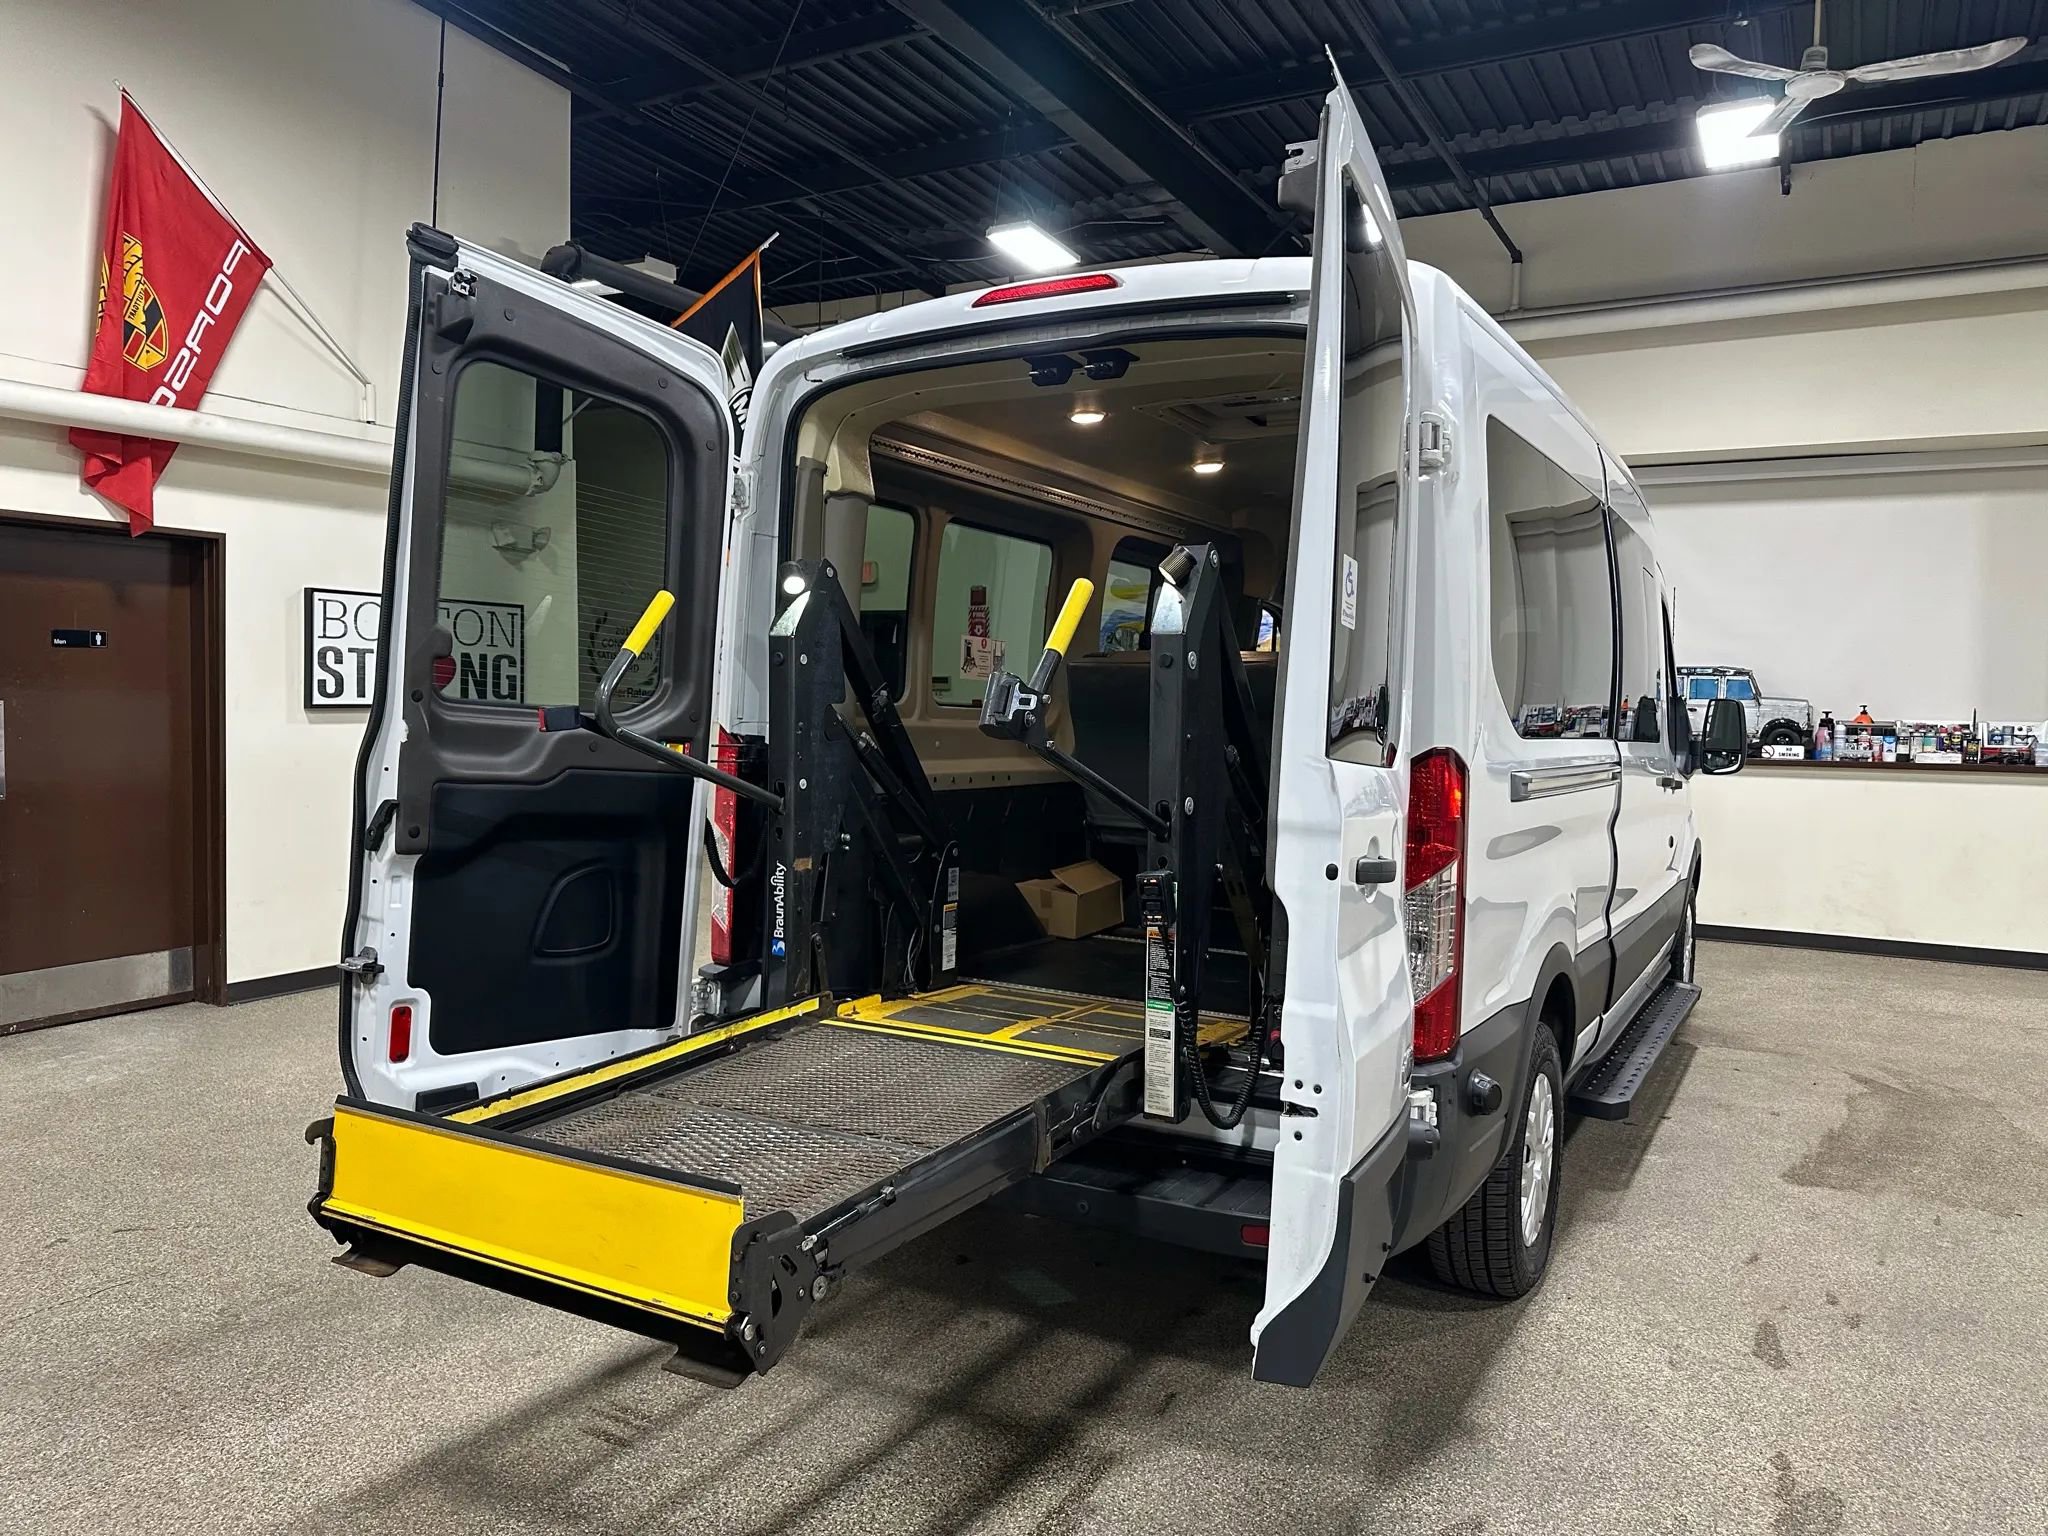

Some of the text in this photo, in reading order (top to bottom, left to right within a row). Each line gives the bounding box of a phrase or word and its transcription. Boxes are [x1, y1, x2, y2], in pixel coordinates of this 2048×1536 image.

[317, 598, 518, 649] BOON
[317, 645, 518, 701] STNG
[770, 860, 787, 939] BraunAbility
